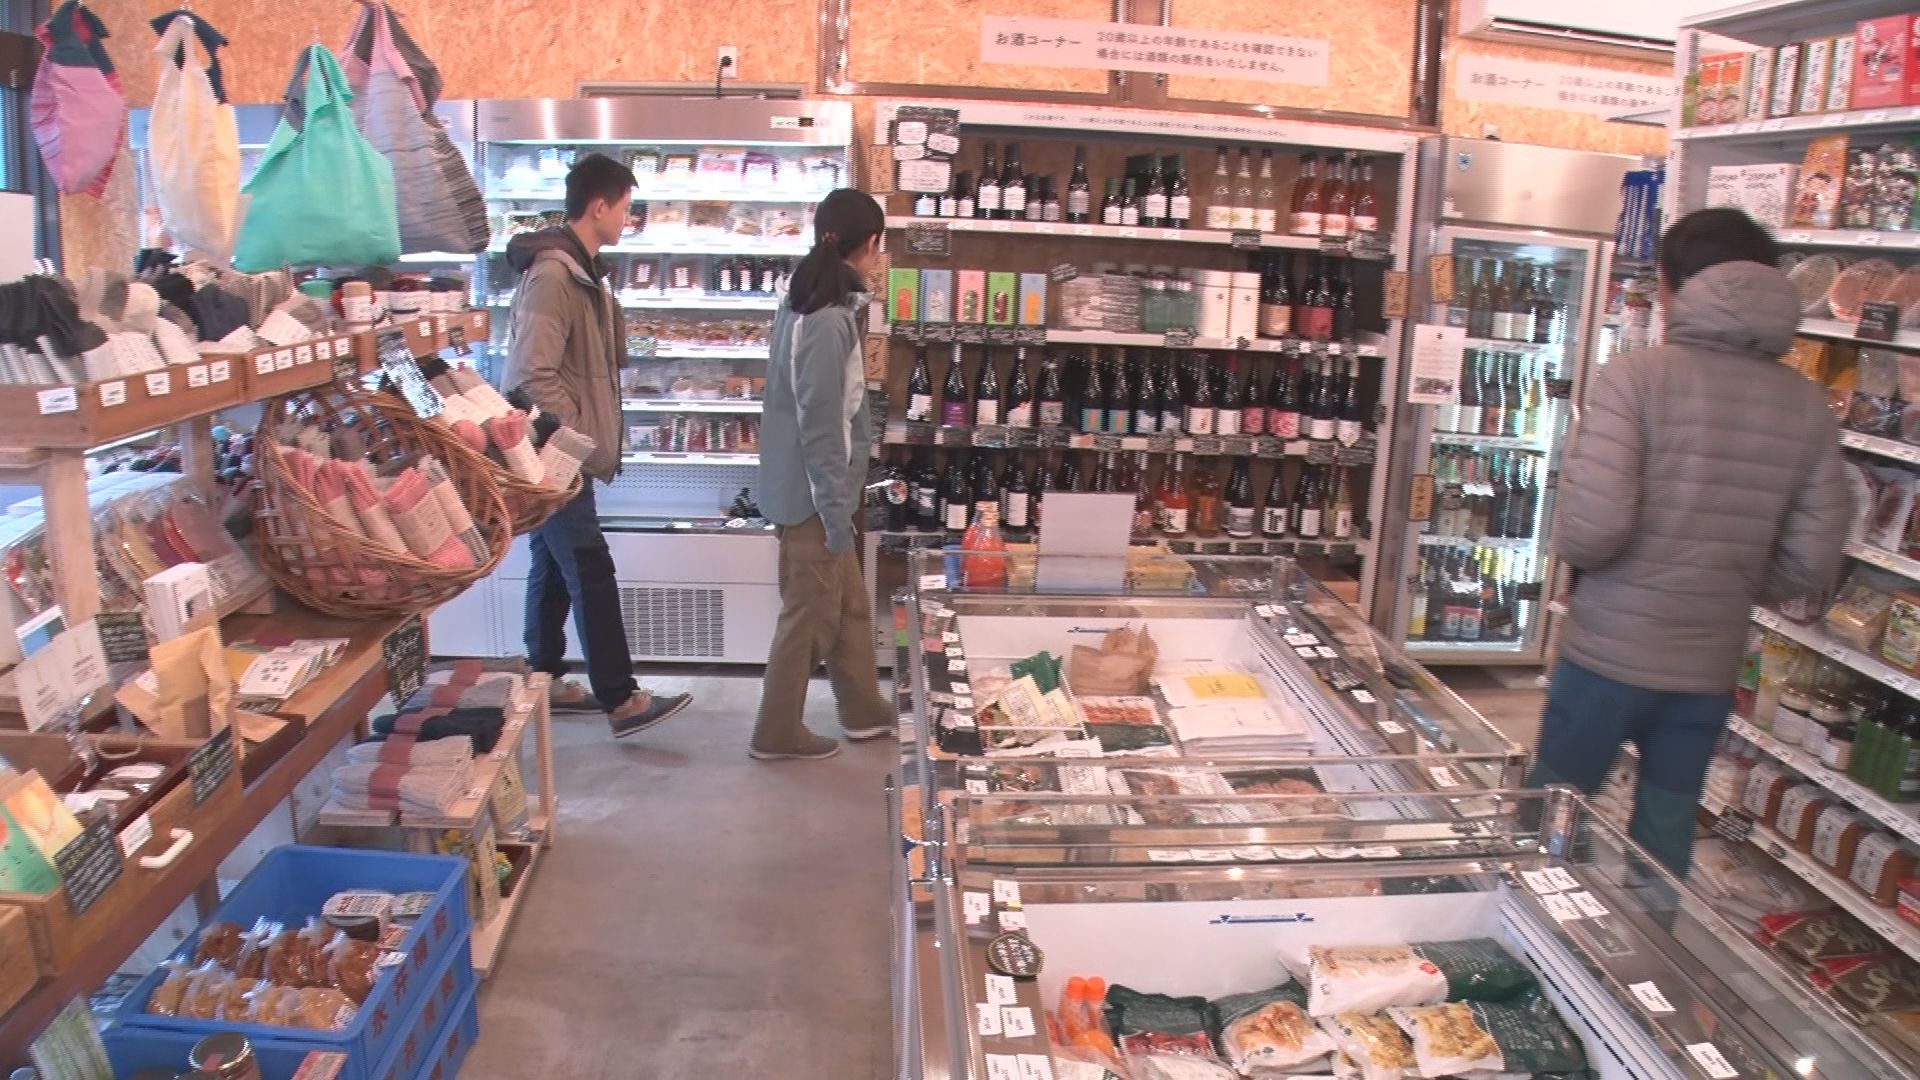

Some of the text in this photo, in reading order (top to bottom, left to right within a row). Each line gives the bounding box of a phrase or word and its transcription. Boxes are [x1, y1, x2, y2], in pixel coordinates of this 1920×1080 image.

[995, 32, 1082, 48] お酒コーナー
[1097, 31, 1318, 58] 20歳以上の年齢であることを確認できない
[1097, 48, 1286, 73] 場合には酒類の販売をいたしません。
[1470, 73, 1545, 89] お酒コーナー
[867, 337, 884, 377] ワイン
